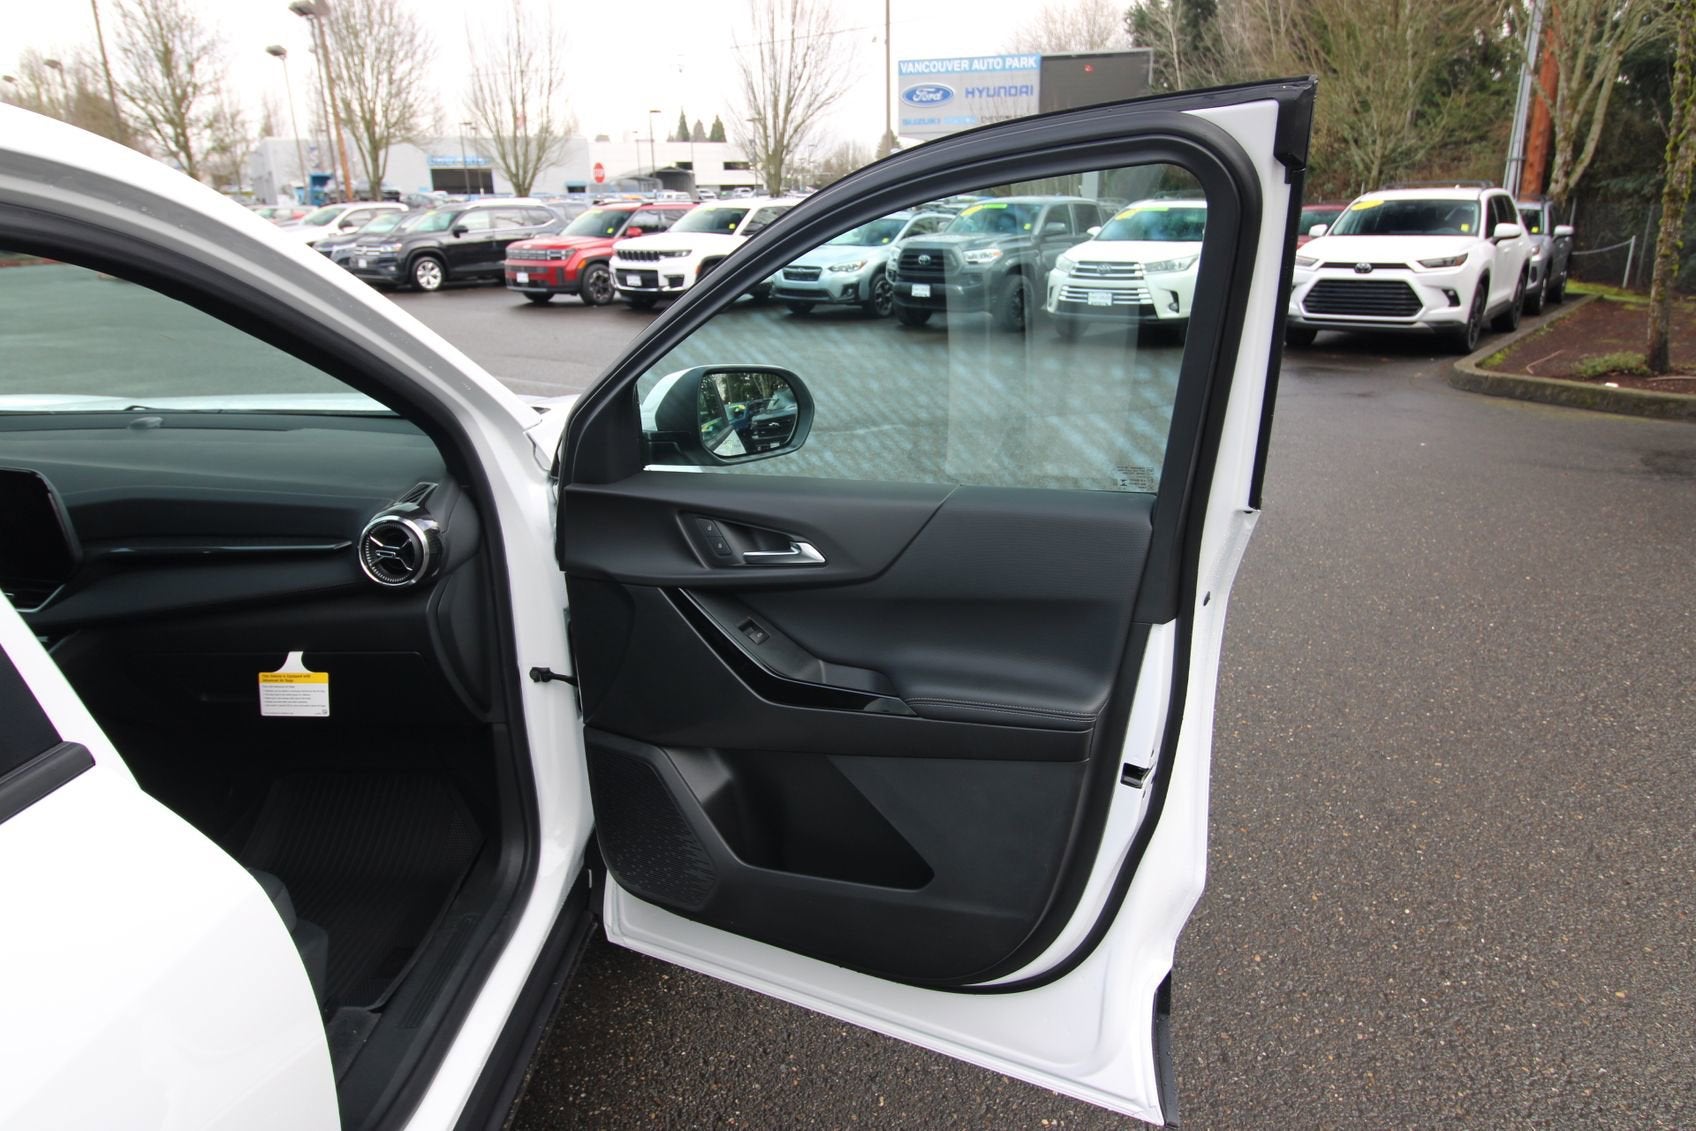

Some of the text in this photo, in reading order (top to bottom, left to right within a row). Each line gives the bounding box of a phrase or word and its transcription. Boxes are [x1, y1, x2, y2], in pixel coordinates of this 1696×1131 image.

[900, 55, 1037, 73] VANCOUVER AUTO PARK
[965, 85, 1034, 98] HYUNDAI
